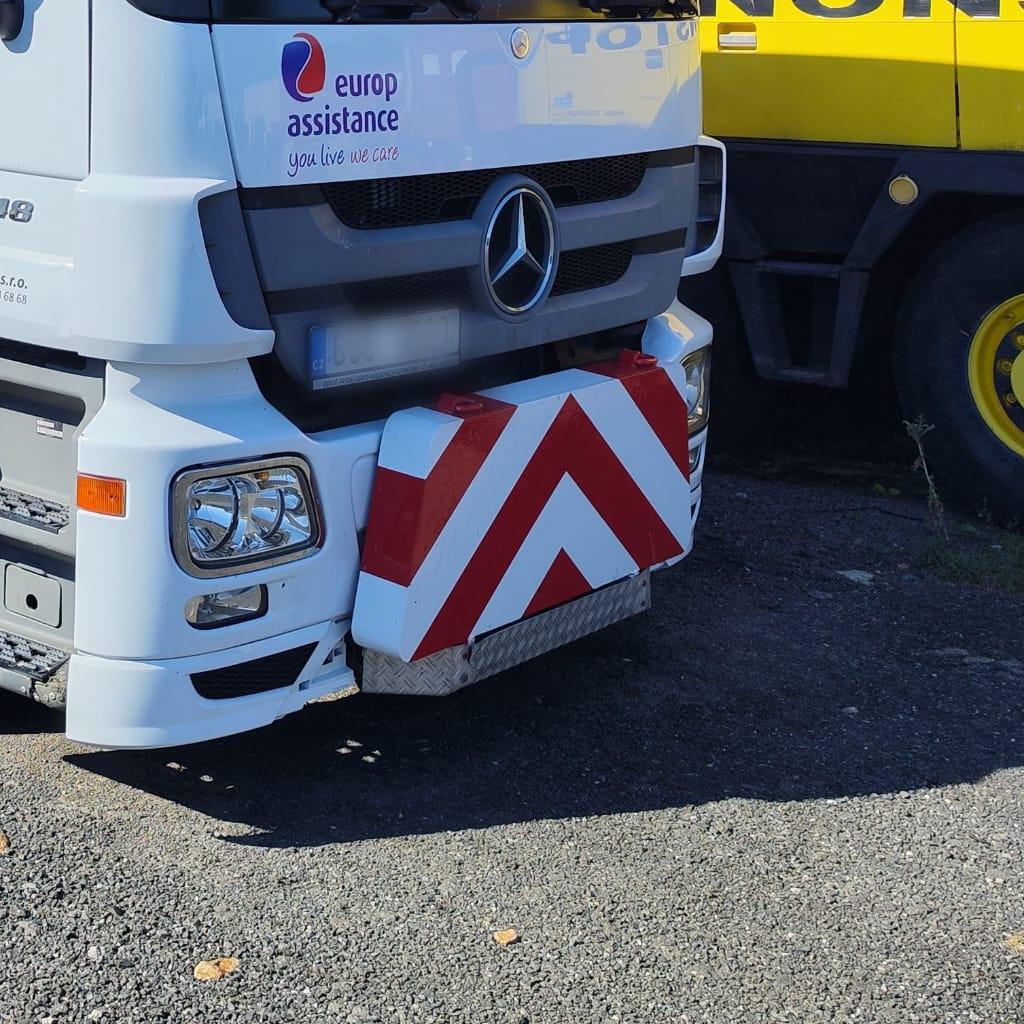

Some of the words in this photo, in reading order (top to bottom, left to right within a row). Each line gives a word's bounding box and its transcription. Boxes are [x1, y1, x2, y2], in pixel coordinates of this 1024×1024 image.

[335, 72, 398, 102] europ
[287, 104, 399, 137] assistance
[287, 151, 317, 178] you
[320, 141, 345, 167] live
[350, 147, 369, 164] we
[372, 145, 400, 162] care
[0, 274, 28, 290] s.r.o.
[3, 291, 15, 303] 68
[16, 294, 27, 305] 68
